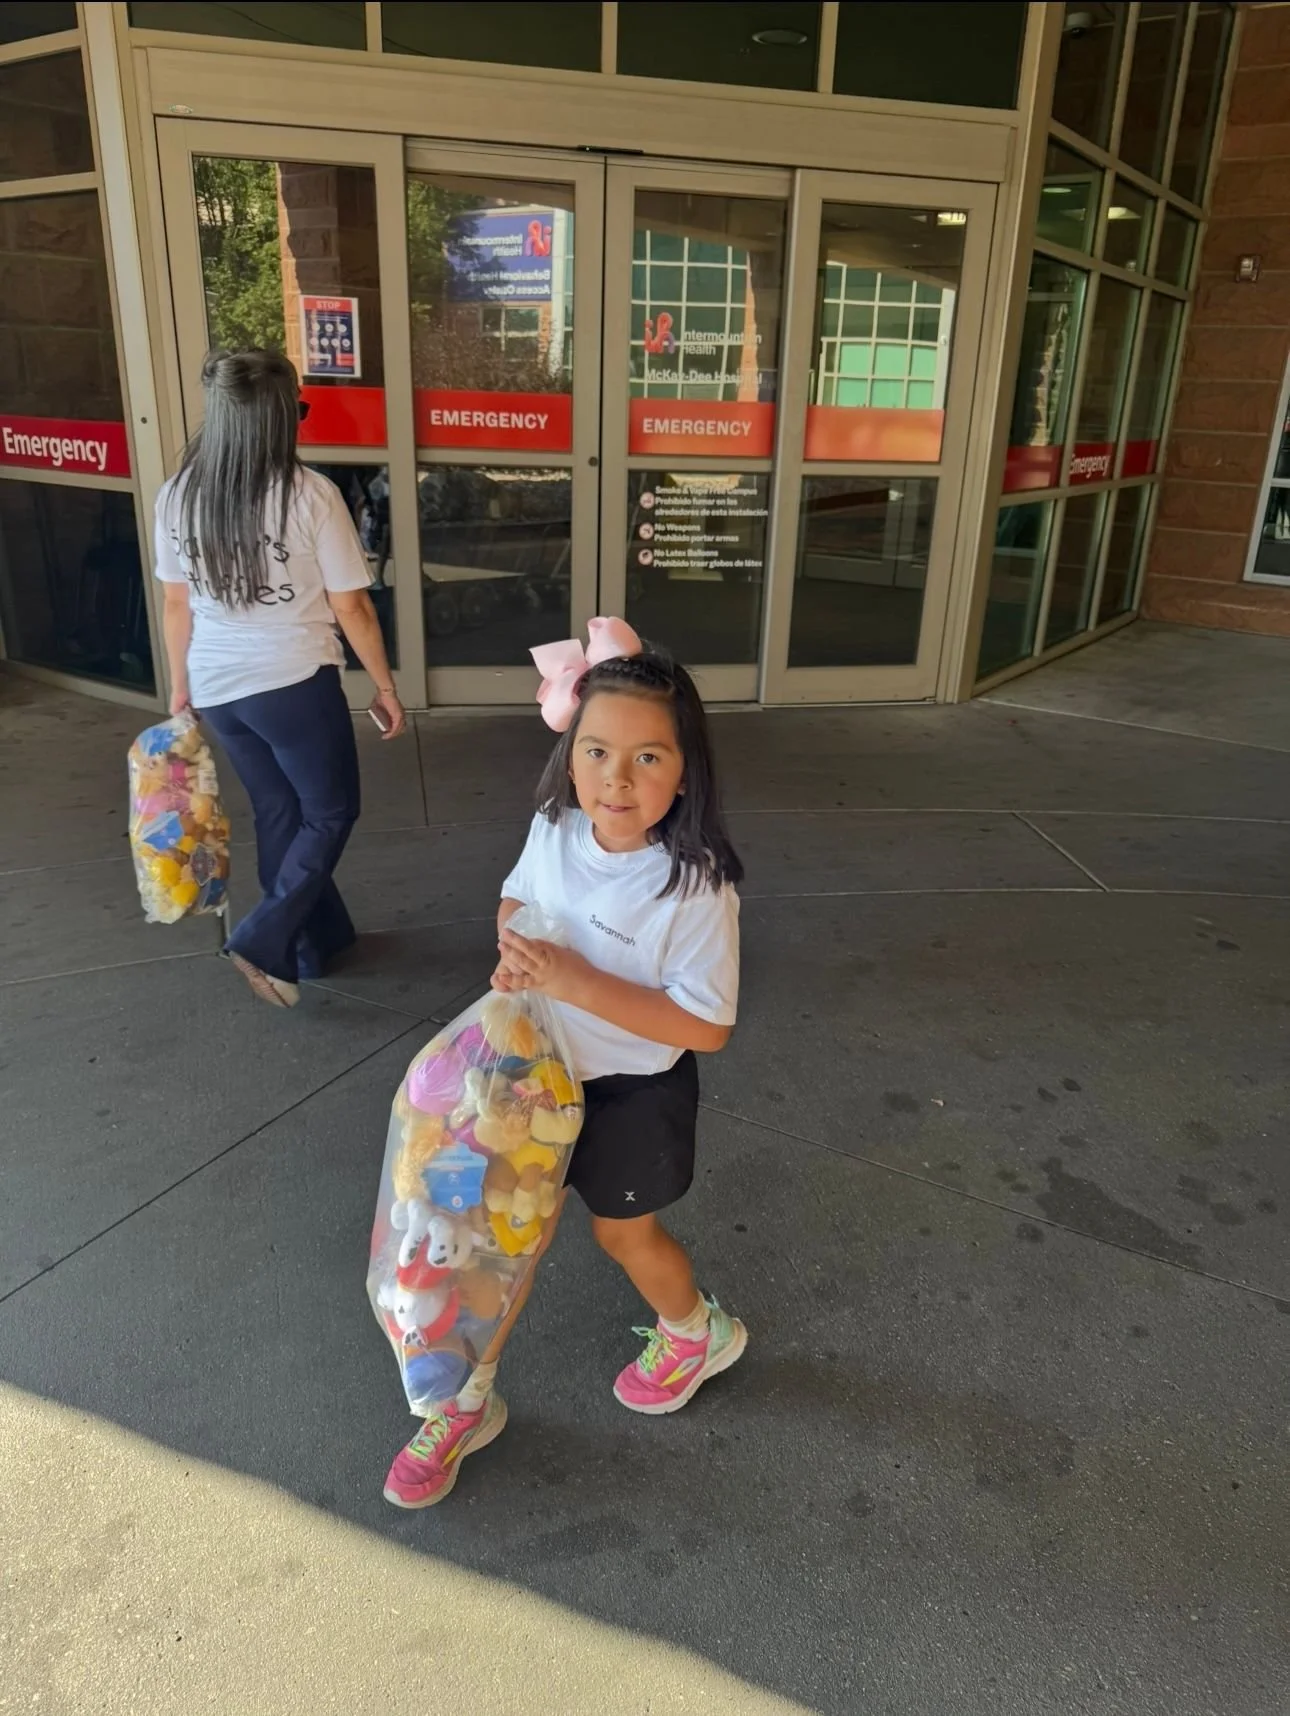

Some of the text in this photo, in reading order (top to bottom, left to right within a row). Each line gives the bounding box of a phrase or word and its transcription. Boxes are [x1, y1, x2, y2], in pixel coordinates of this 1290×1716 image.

[316, 300, 341, 310] STOP
[430, 408, 549, 430] EMERGENCY
[642, 417, 753, 437] EMERGENCY
[2, 427, 108, 471] Emergency
[654, 496, 692, 505] Prohibido
[692, 497, 715, 506] fumar
[654, 507, 700, 517] alrededores
[700, 508, 711, 517] de
[711, 509, 728, 517] esta
[654, 523, 701, 532] No Weapons
[653, 533, 740, 544] Prohibido portar armas
[653, 549, 719, 557] No Latex Balloons
[653, 559, 690, 568] Prohibido
[690, 560, 709, 568] traer
[709, 560, 734, 569] globos
[734, 560, 744, 568] de
[588, 913, 637, 947] Savannah
